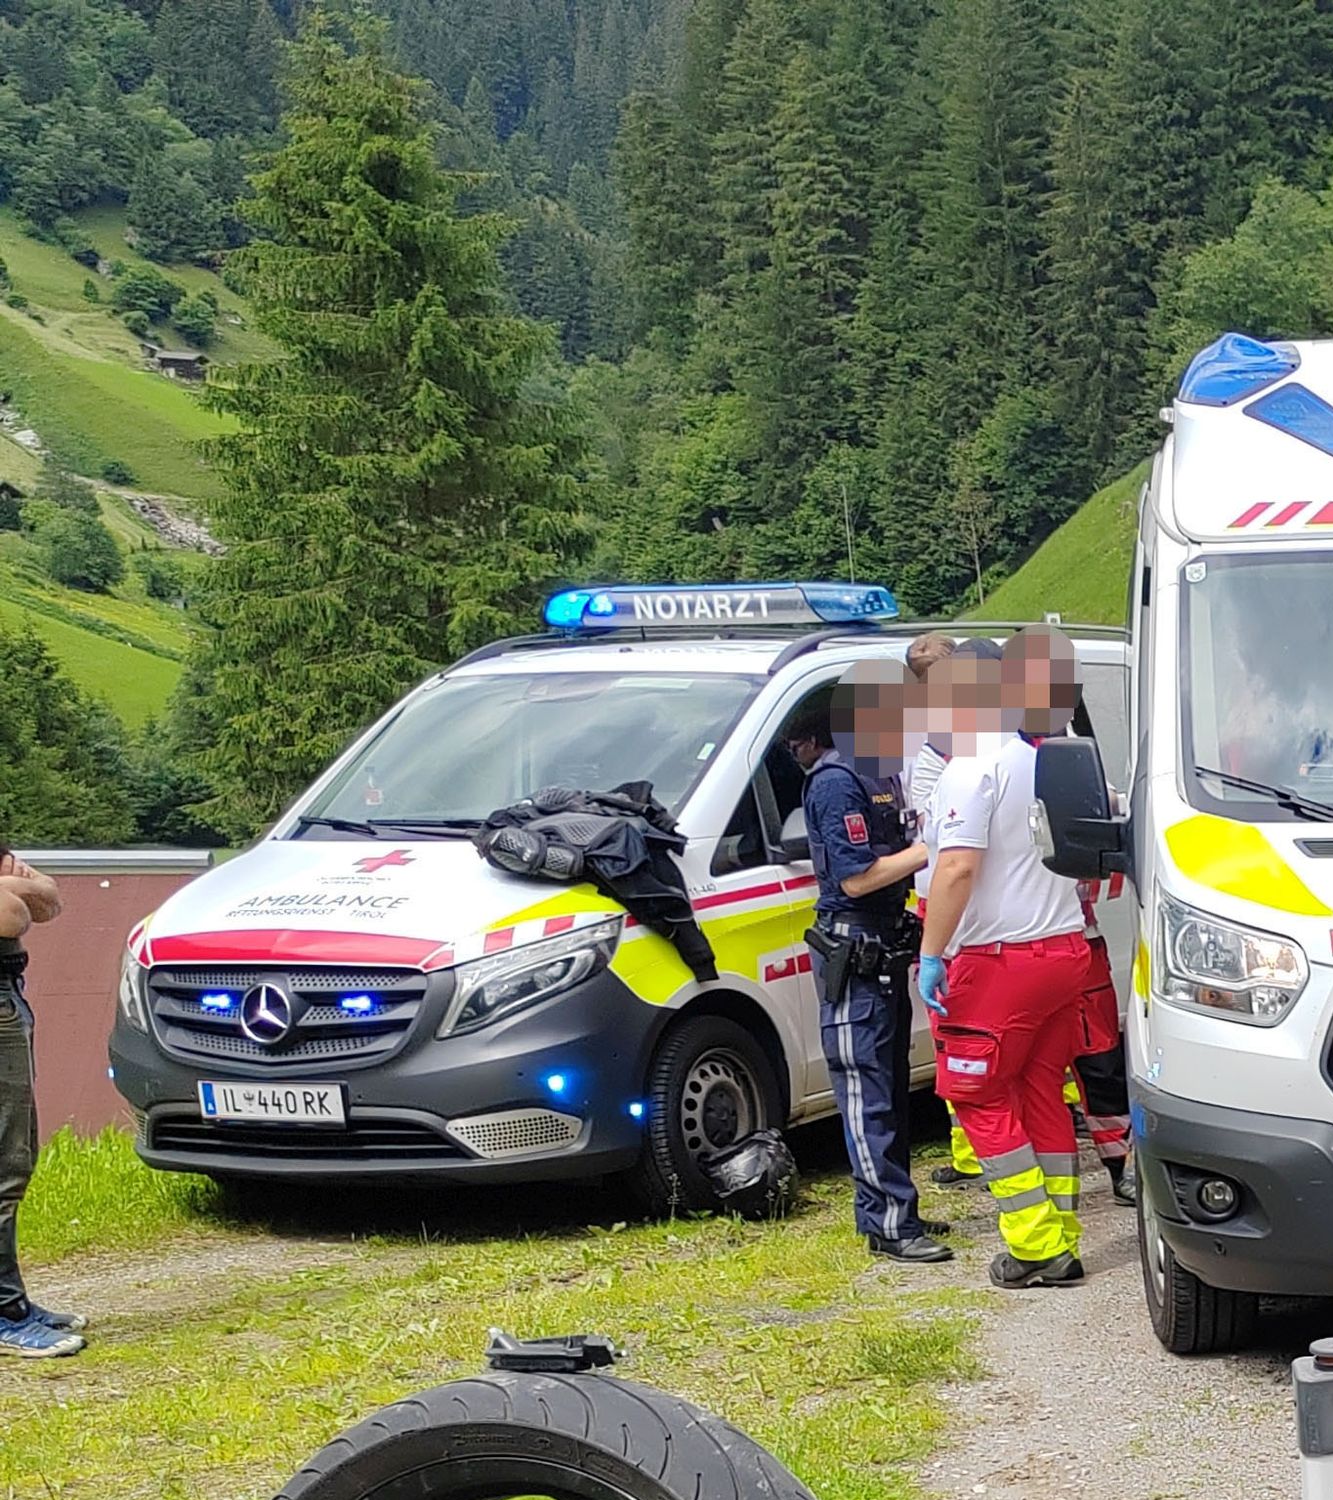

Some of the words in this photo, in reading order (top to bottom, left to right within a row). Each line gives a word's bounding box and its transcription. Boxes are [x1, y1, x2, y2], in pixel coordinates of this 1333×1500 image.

[633, 592, 772, 621] NOTARZT
[238, 893, 410, 909] AMBULANCE
[222, 1088, 242, 1112] IL
[257, 1089, 298, 1115] 440
[302, 1091, 332, 1116] RK
